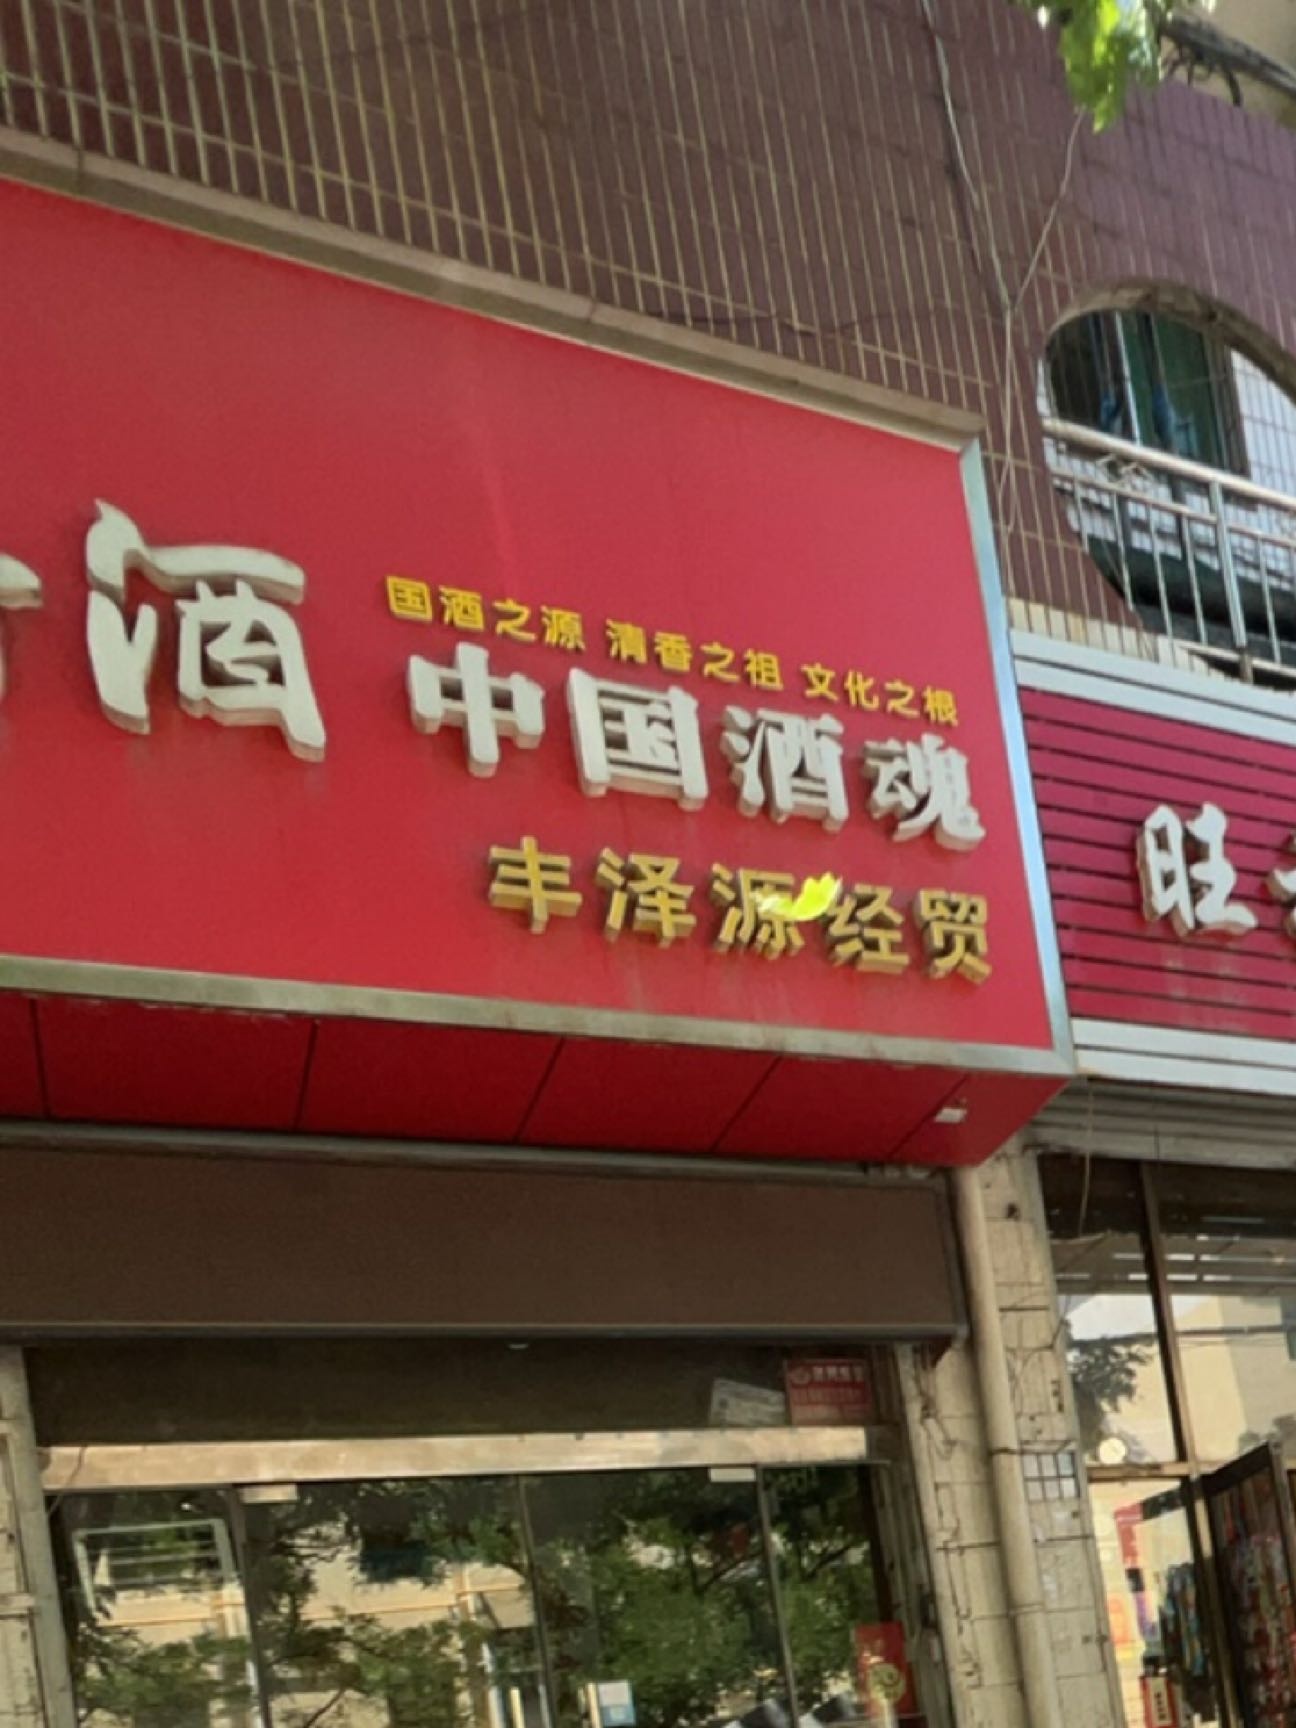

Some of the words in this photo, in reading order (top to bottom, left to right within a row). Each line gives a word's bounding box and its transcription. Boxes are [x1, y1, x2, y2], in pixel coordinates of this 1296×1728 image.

[0, 498, 328, 762] 酒
[386, 575, 586, 650] 国酒之源
[606, 618, 783, 690] 清香之祖
[802, 664, 958, 726] 文化之根
[407, 642, 986, 850] 中国酒魂
[487, 836, 990, 984] 丰泽源经贸
